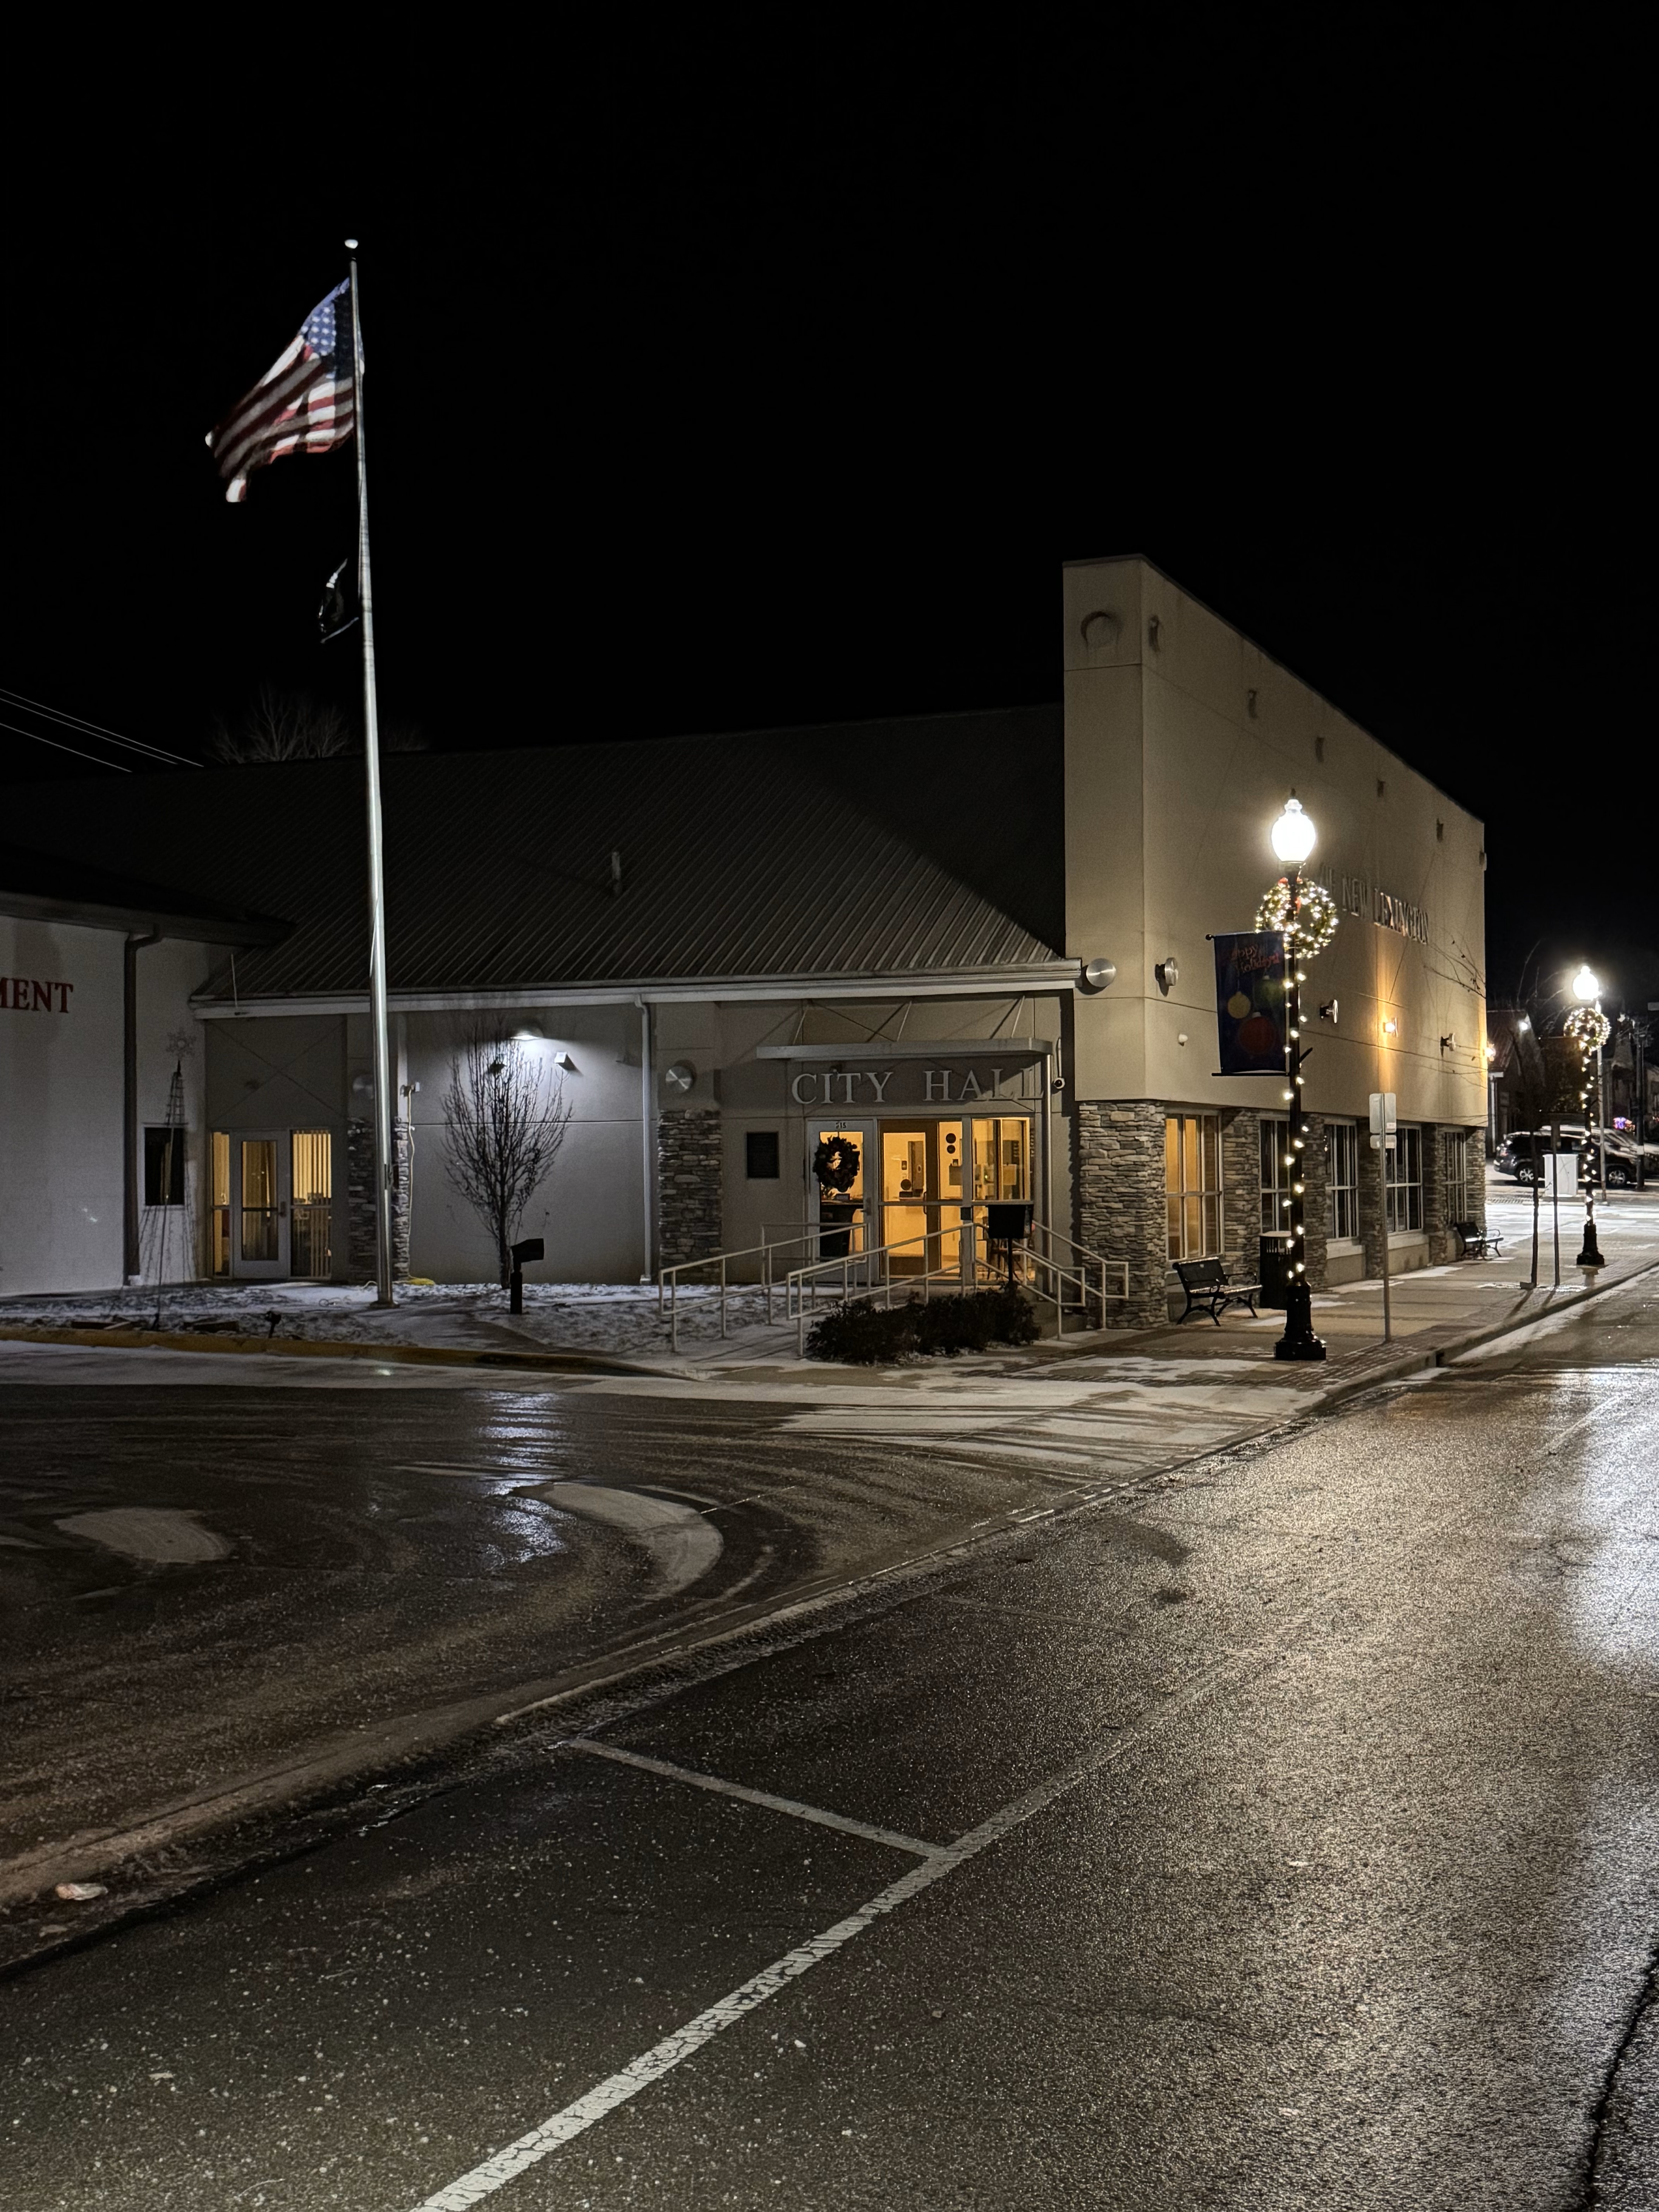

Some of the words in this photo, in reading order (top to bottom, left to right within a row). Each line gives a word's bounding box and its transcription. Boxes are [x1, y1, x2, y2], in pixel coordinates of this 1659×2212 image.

[1342, 876, 1370, 917] NEW
[792, 1071, 893, 1104] CITY
[923, 1068, 1044, 1101] HALL
